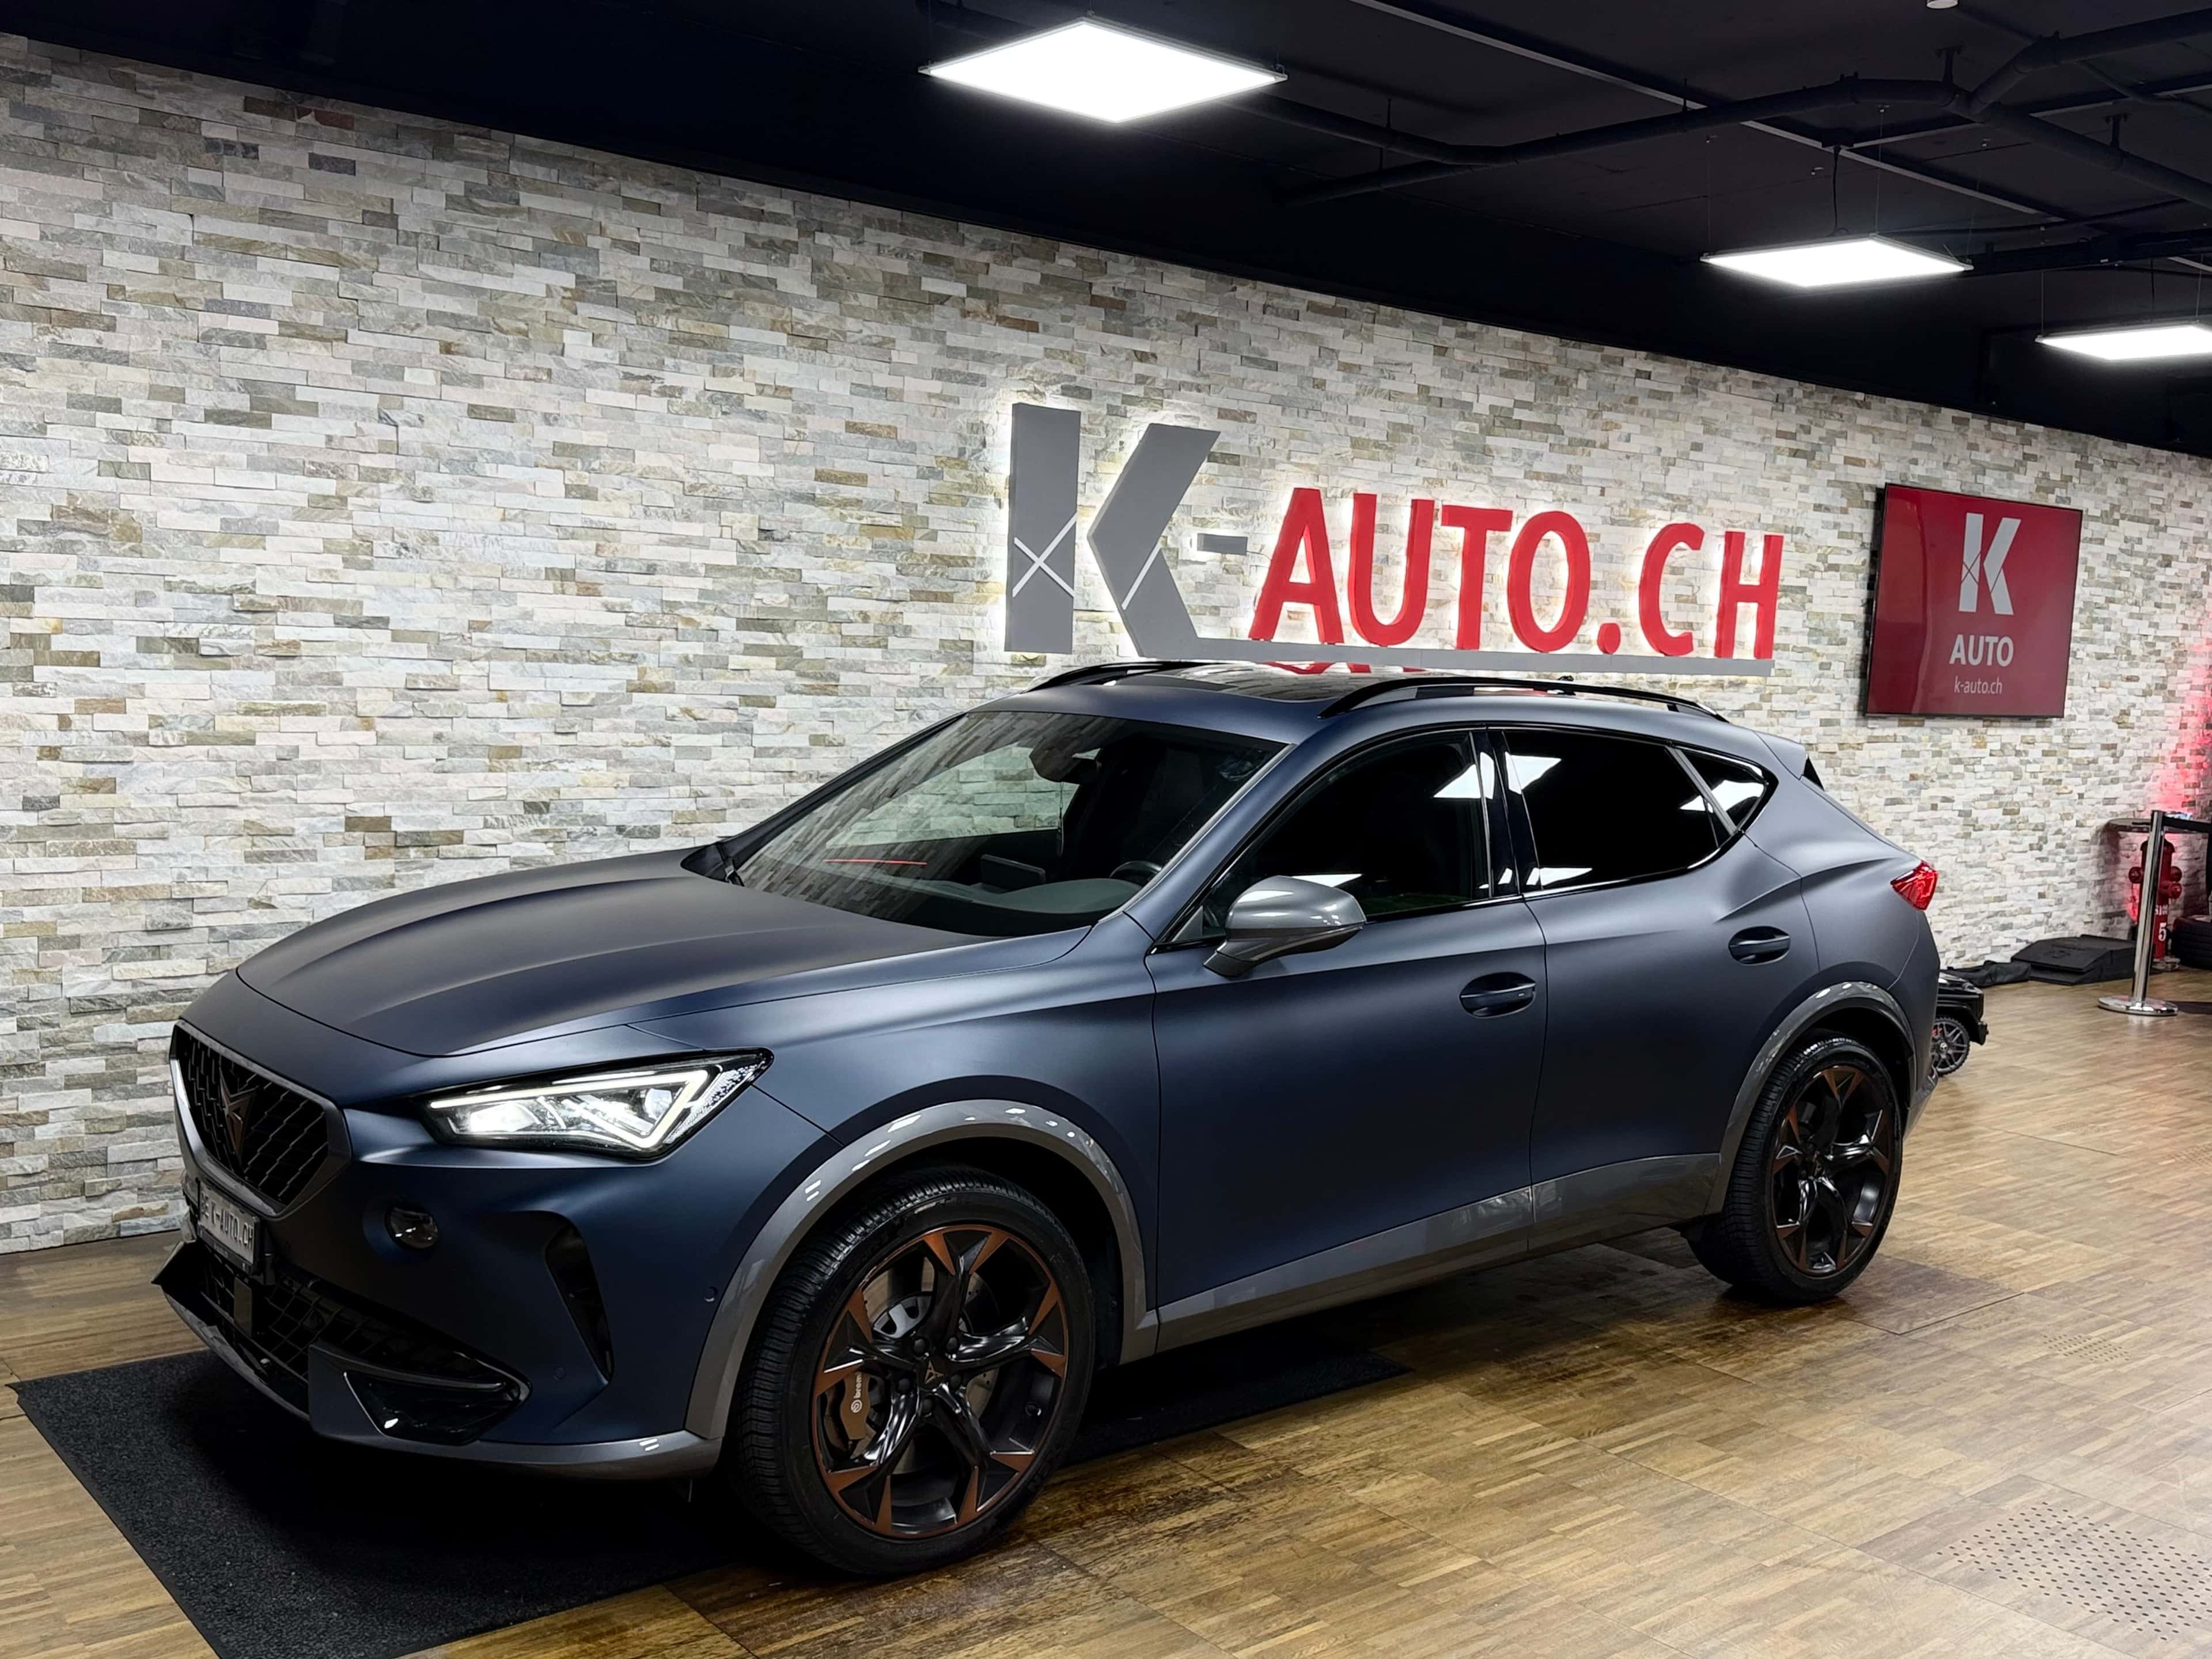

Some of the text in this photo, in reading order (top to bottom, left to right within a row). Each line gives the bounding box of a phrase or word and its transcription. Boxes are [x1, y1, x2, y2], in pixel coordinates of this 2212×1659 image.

[1959, 512, 2021, 615] K
[1949, 634, 2014, 667] AUTO
[1954, 676, 2003, 695] k-auto.ch
[2158, 922, 2166, 941] 5
